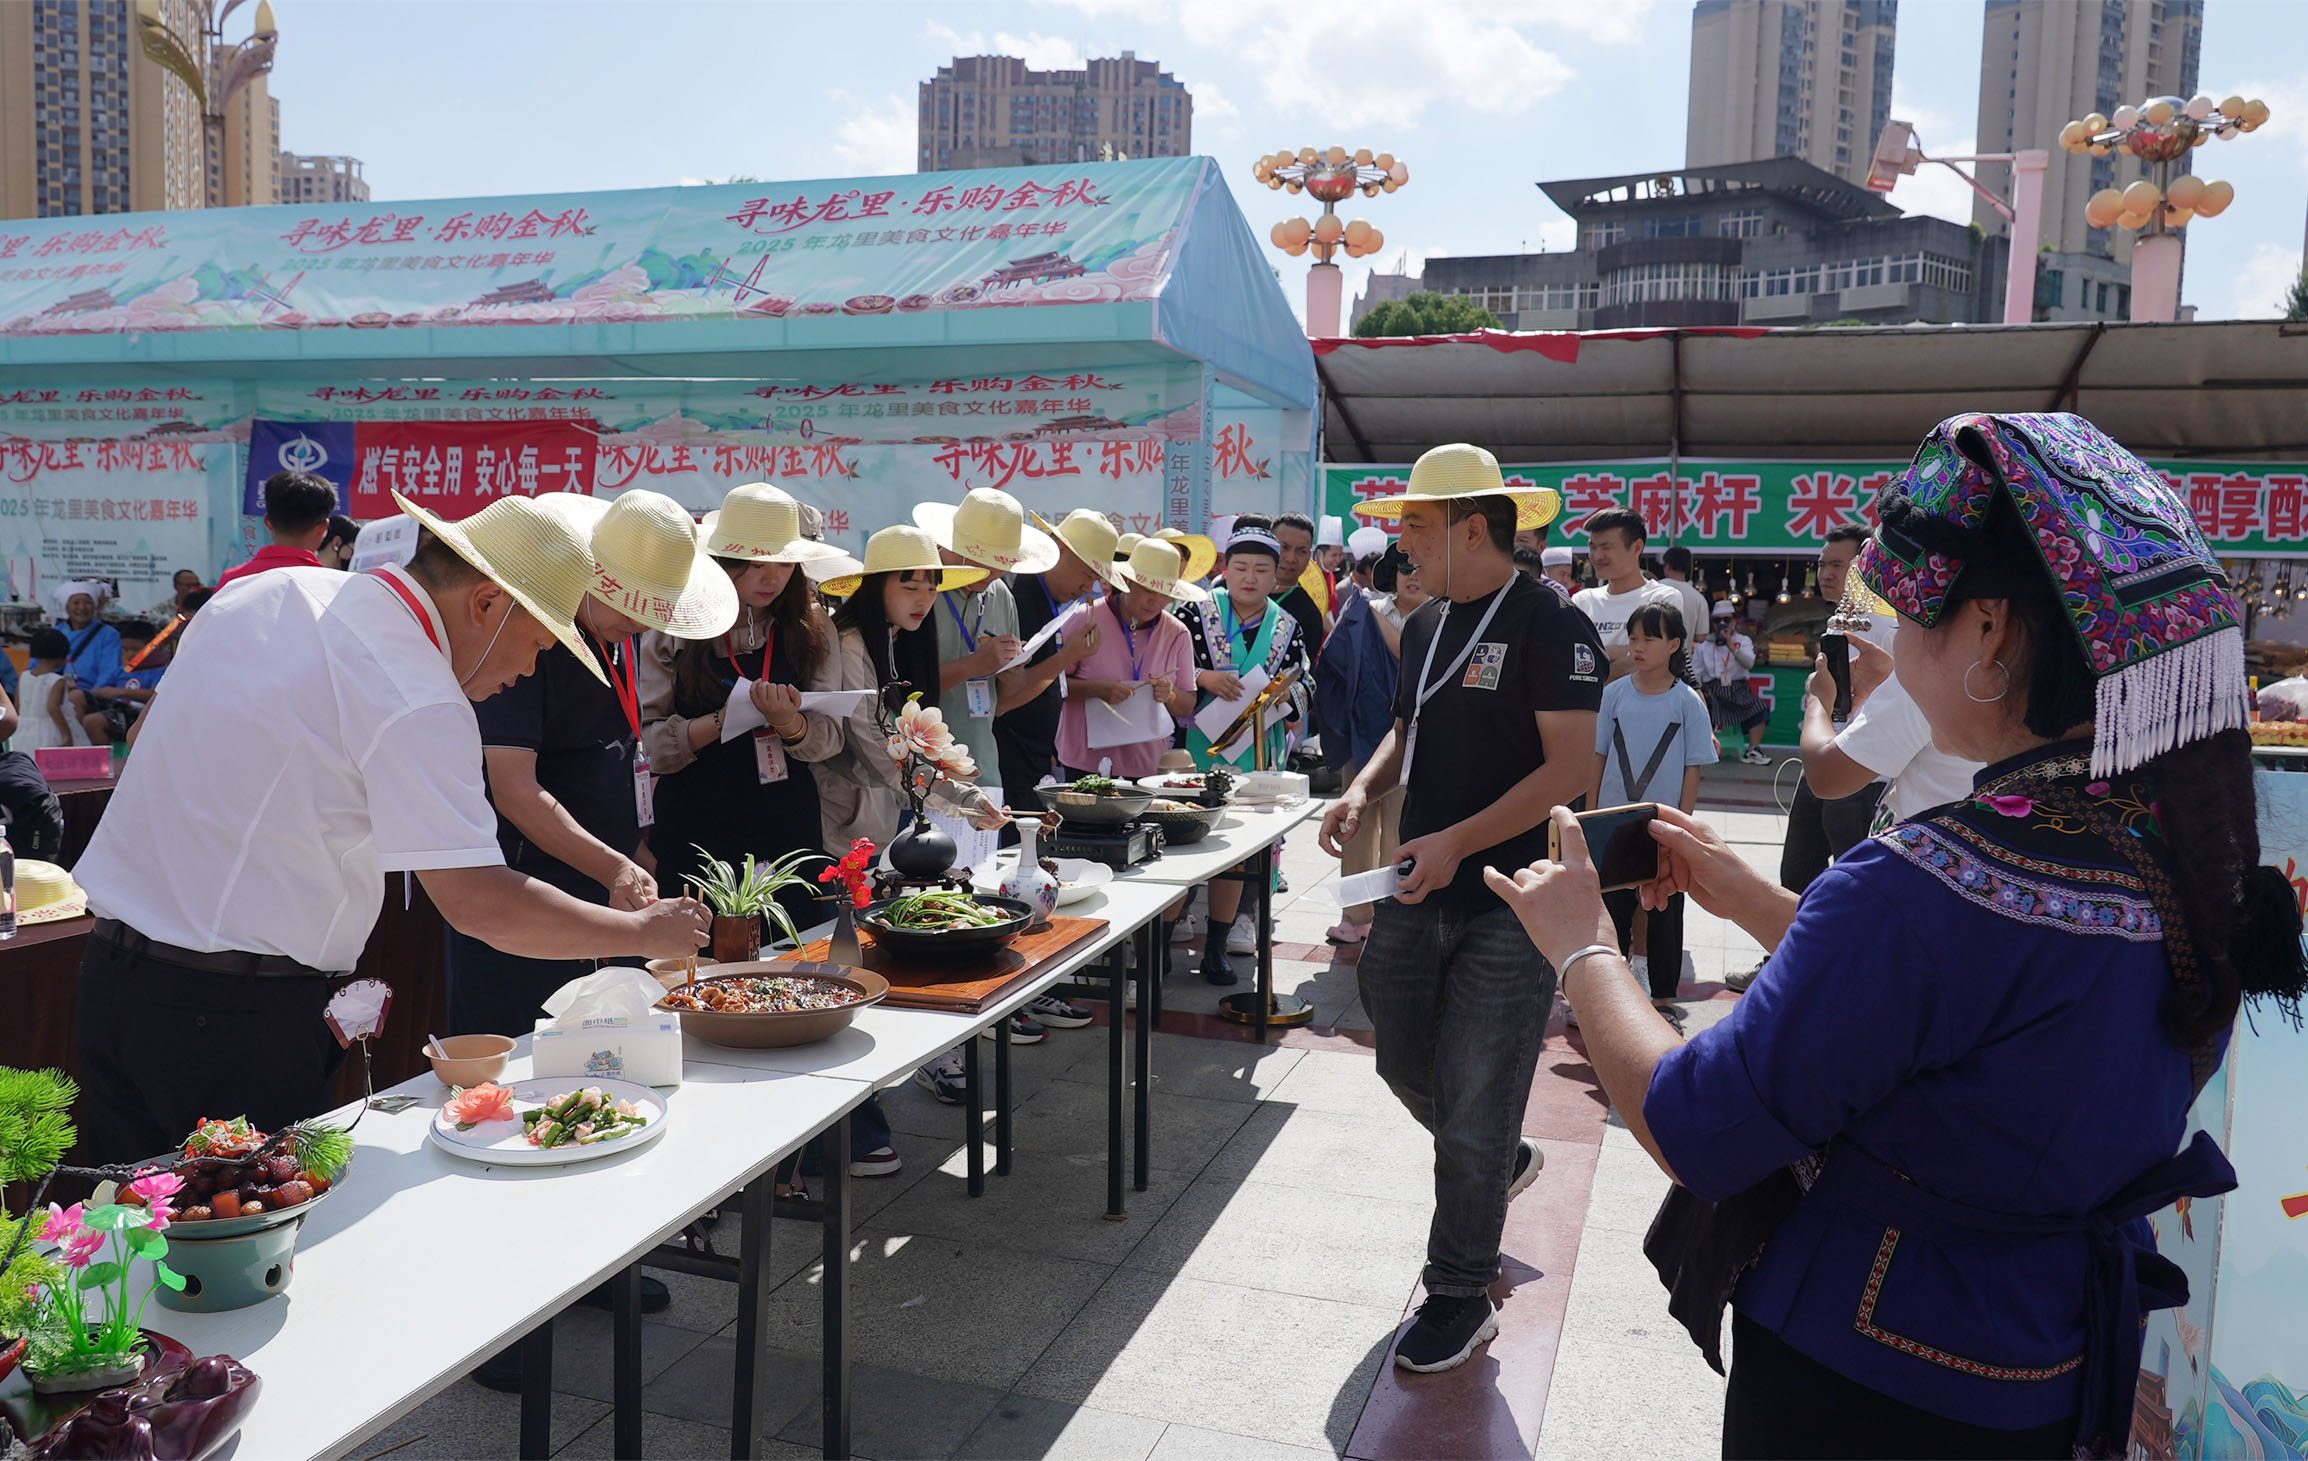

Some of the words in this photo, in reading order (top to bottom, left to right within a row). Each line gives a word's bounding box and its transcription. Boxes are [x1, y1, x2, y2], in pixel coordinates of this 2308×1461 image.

[735, 237, 796, 256] 2025
[800, 220, 1068, 252] 年龙里美食文化嘉年华
[774, 402, 829, 419] 2025
[837, 398, 1092, 419] 年龙里美食文化嘉年华
[357, 444, 464, 497] 燃气安全用
[474, 444, 583, 497] 安心每一天
[34, 498, 198, 522] 年龙里美食文化嘉年华
[1562, 471, 1758, 538] 芝麻杆
